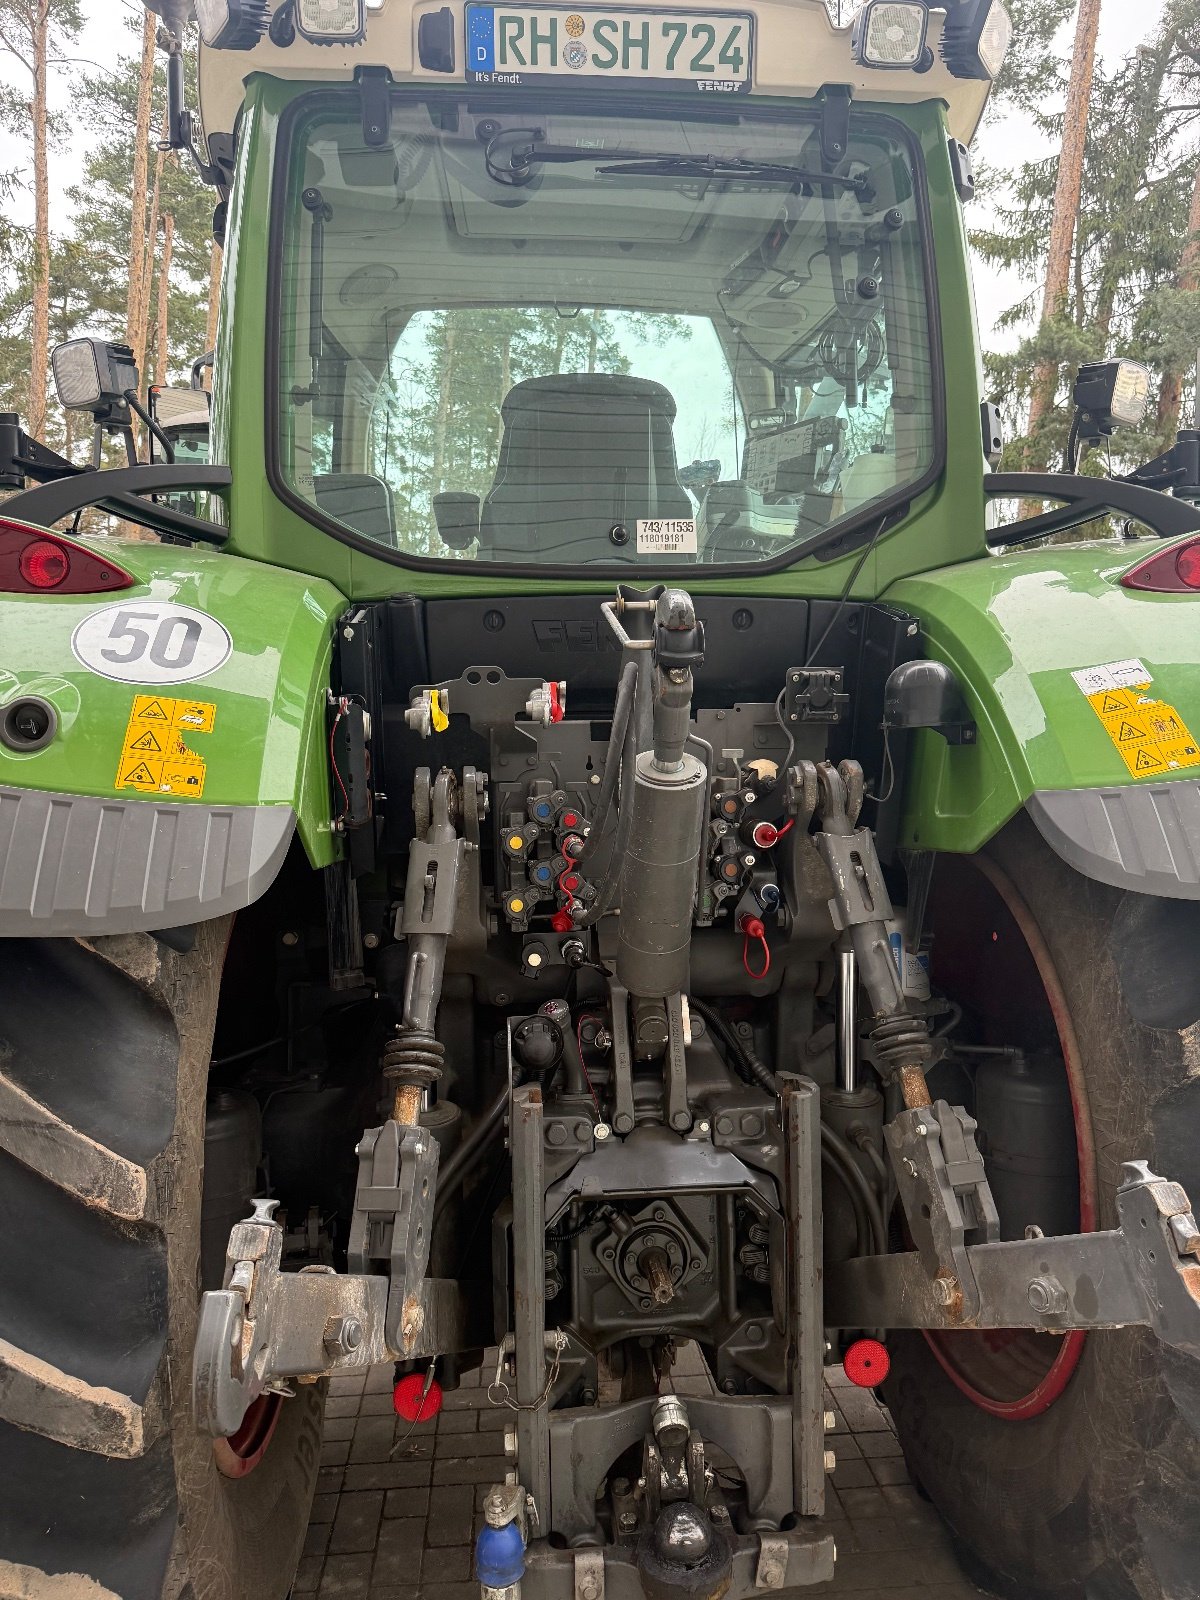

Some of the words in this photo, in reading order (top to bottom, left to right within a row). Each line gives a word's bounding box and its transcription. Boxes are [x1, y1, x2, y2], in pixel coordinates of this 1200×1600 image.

[499, 15, 558, 66] RH
[591, 19, 649, 70] SH
[662, 22, 744, 73] 724
[477, 46, 487, 61] D
[475, 71, 490, 82] It's
[492, 73, 522, 84] Fendt.
[696, 80, 743, 92] FENDT
[100, 611, 203, 669] 50
